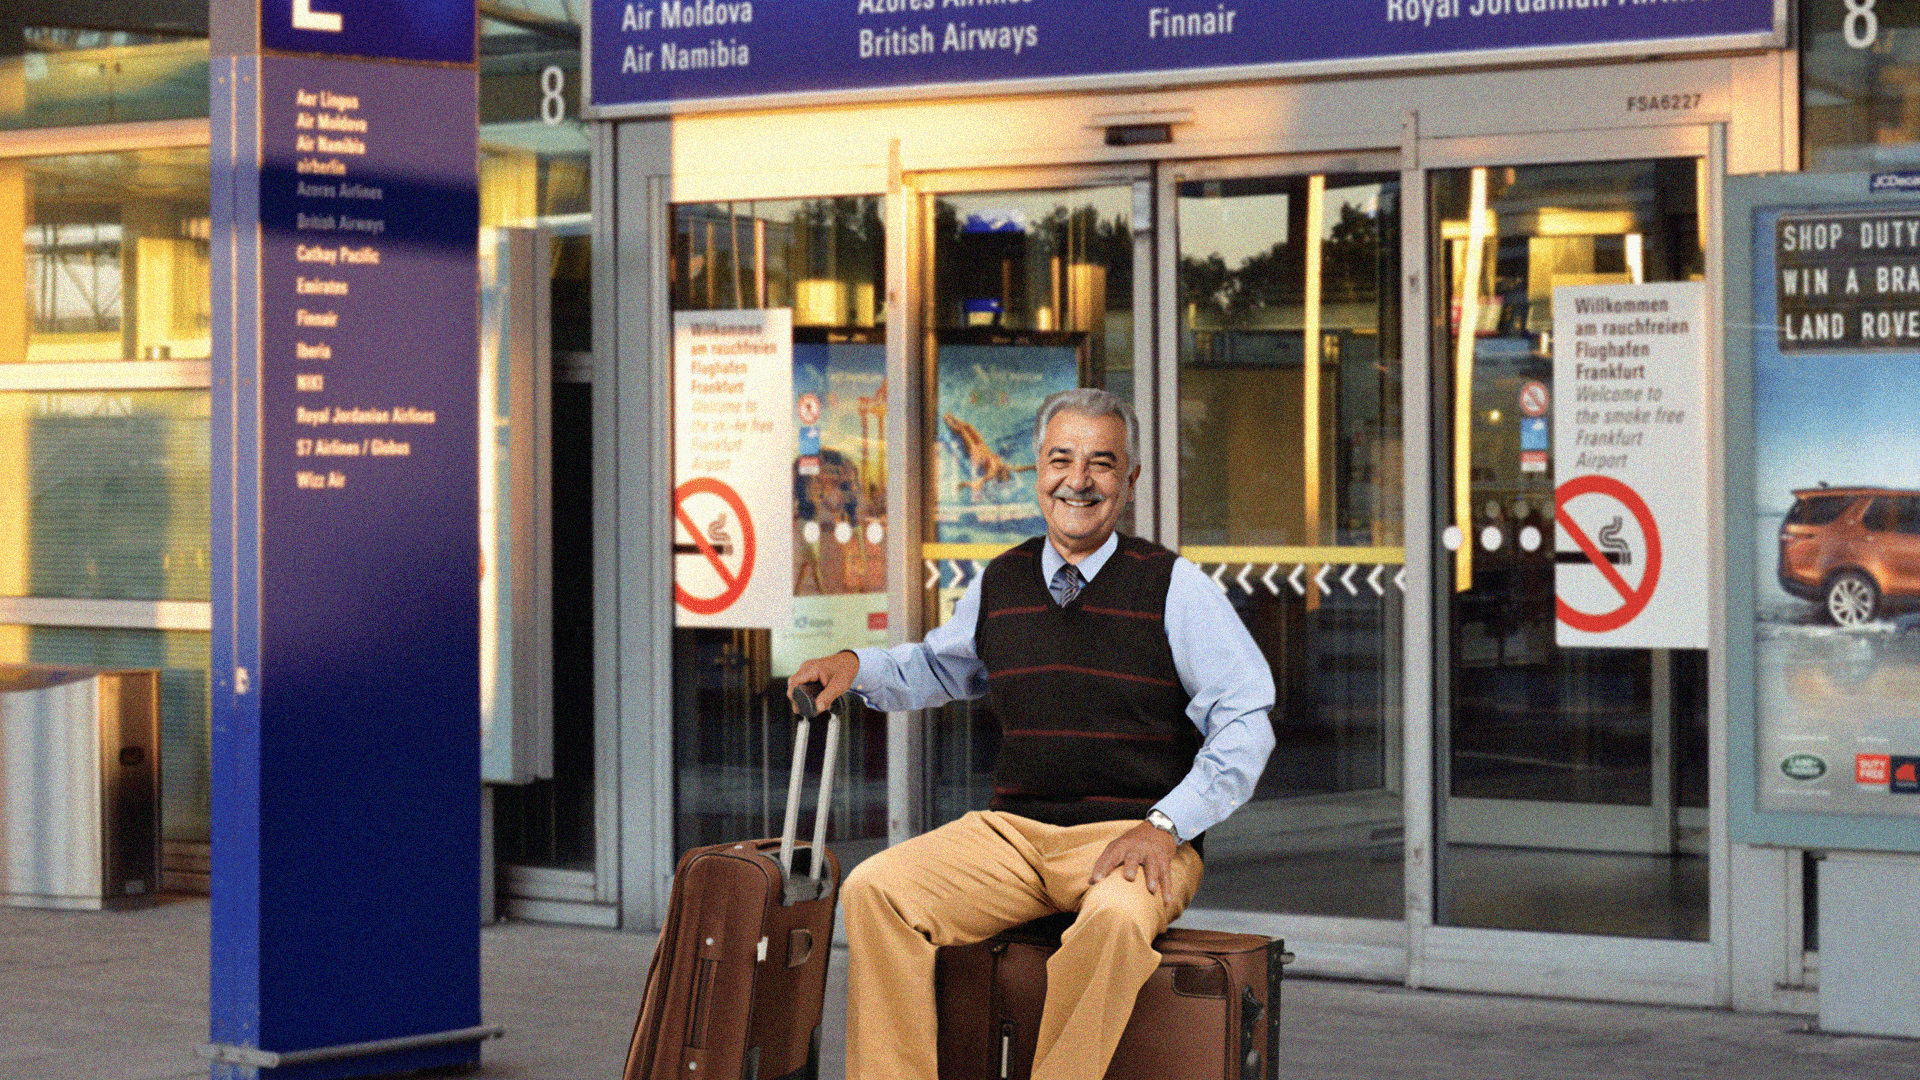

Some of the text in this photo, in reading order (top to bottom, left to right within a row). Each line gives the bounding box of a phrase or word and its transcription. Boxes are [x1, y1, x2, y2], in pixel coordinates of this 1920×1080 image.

[621, 0, 753, 31] Air Moldova
[1149, 7, 1236, 38] Finnair
[1843, 0, 1877, 49] 8
[859, 21, 1038, 58] British Airways
[622, 38, 749, 73] Air Namibia
[541, 65, 565, 125] 8
[1627, 92, 1701, 111] FSA6227
[1784, 221, 1920, 251] SHOP DUTY
[1783, 265, 1920, 295] WIN A BRA
[1575, 298, 1669, 314] Willkommen
[1575, 319, 1689, 335] am rauchfreien
[1786, 310, 1920, 340] LAND ROVE
[1576, 340, 1650, 361] Flughafen
[1576, 364, 1645, 380] Frankfurt
[1576, 387, 1662, 402] Welcome to
[1576, 407, 1685, 424] the smoke free
[1576, 429, 1643, 446] Frankfurt
[1576, 452, 1628, 470] Airport
